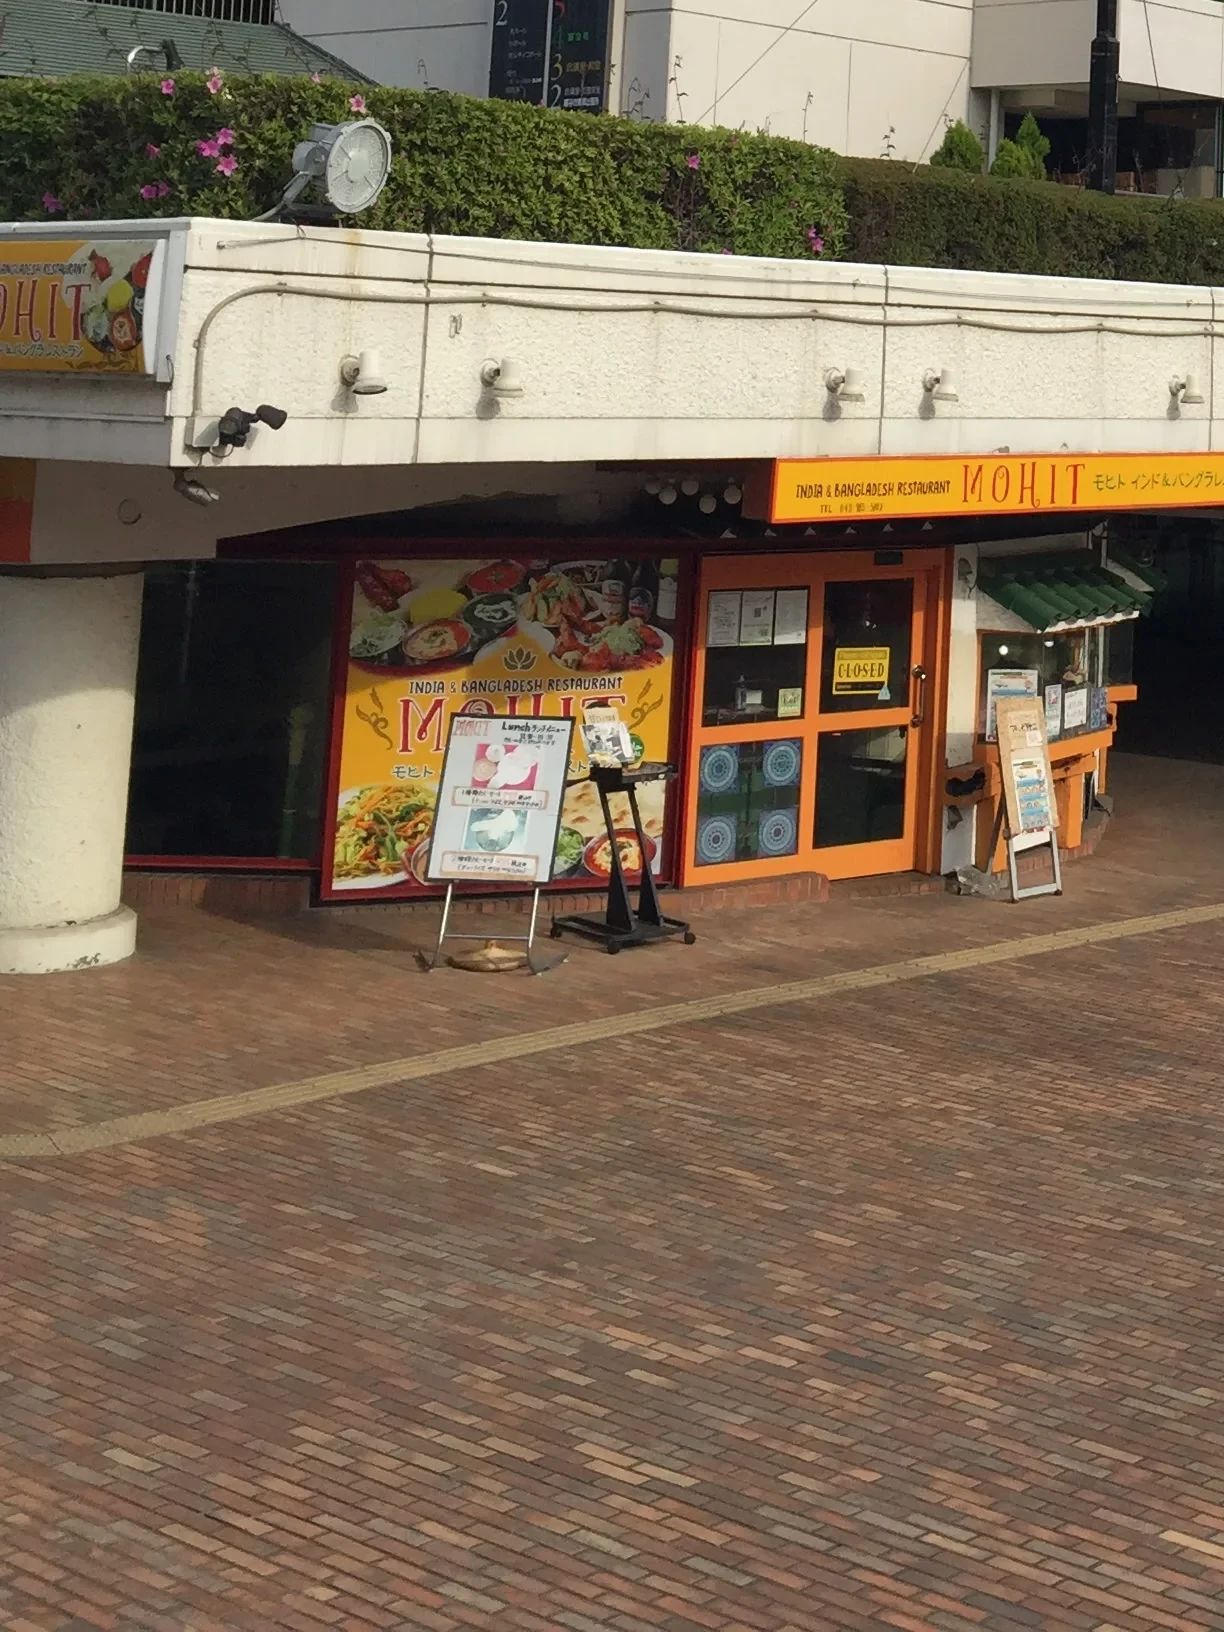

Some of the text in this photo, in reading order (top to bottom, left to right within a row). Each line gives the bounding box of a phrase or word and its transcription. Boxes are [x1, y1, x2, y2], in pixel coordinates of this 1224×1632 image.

[495, 0, 508, 26] 2
[551, 53, 563, 81] 3
[551, 84, 562, 108] 2
[796, 480, 951, 498] INDIA & BANGLADESH RESTAURANT
[962, 461, 1085, 508] MOHIT
[1093, 474, 1125, 491] モヒト
[409, 677, 623, 694] INDIA & BANGLADESH RESTAURANT
[501, 721, 531, 732] Lunch
[392, 765, 434, 779] モヒト
